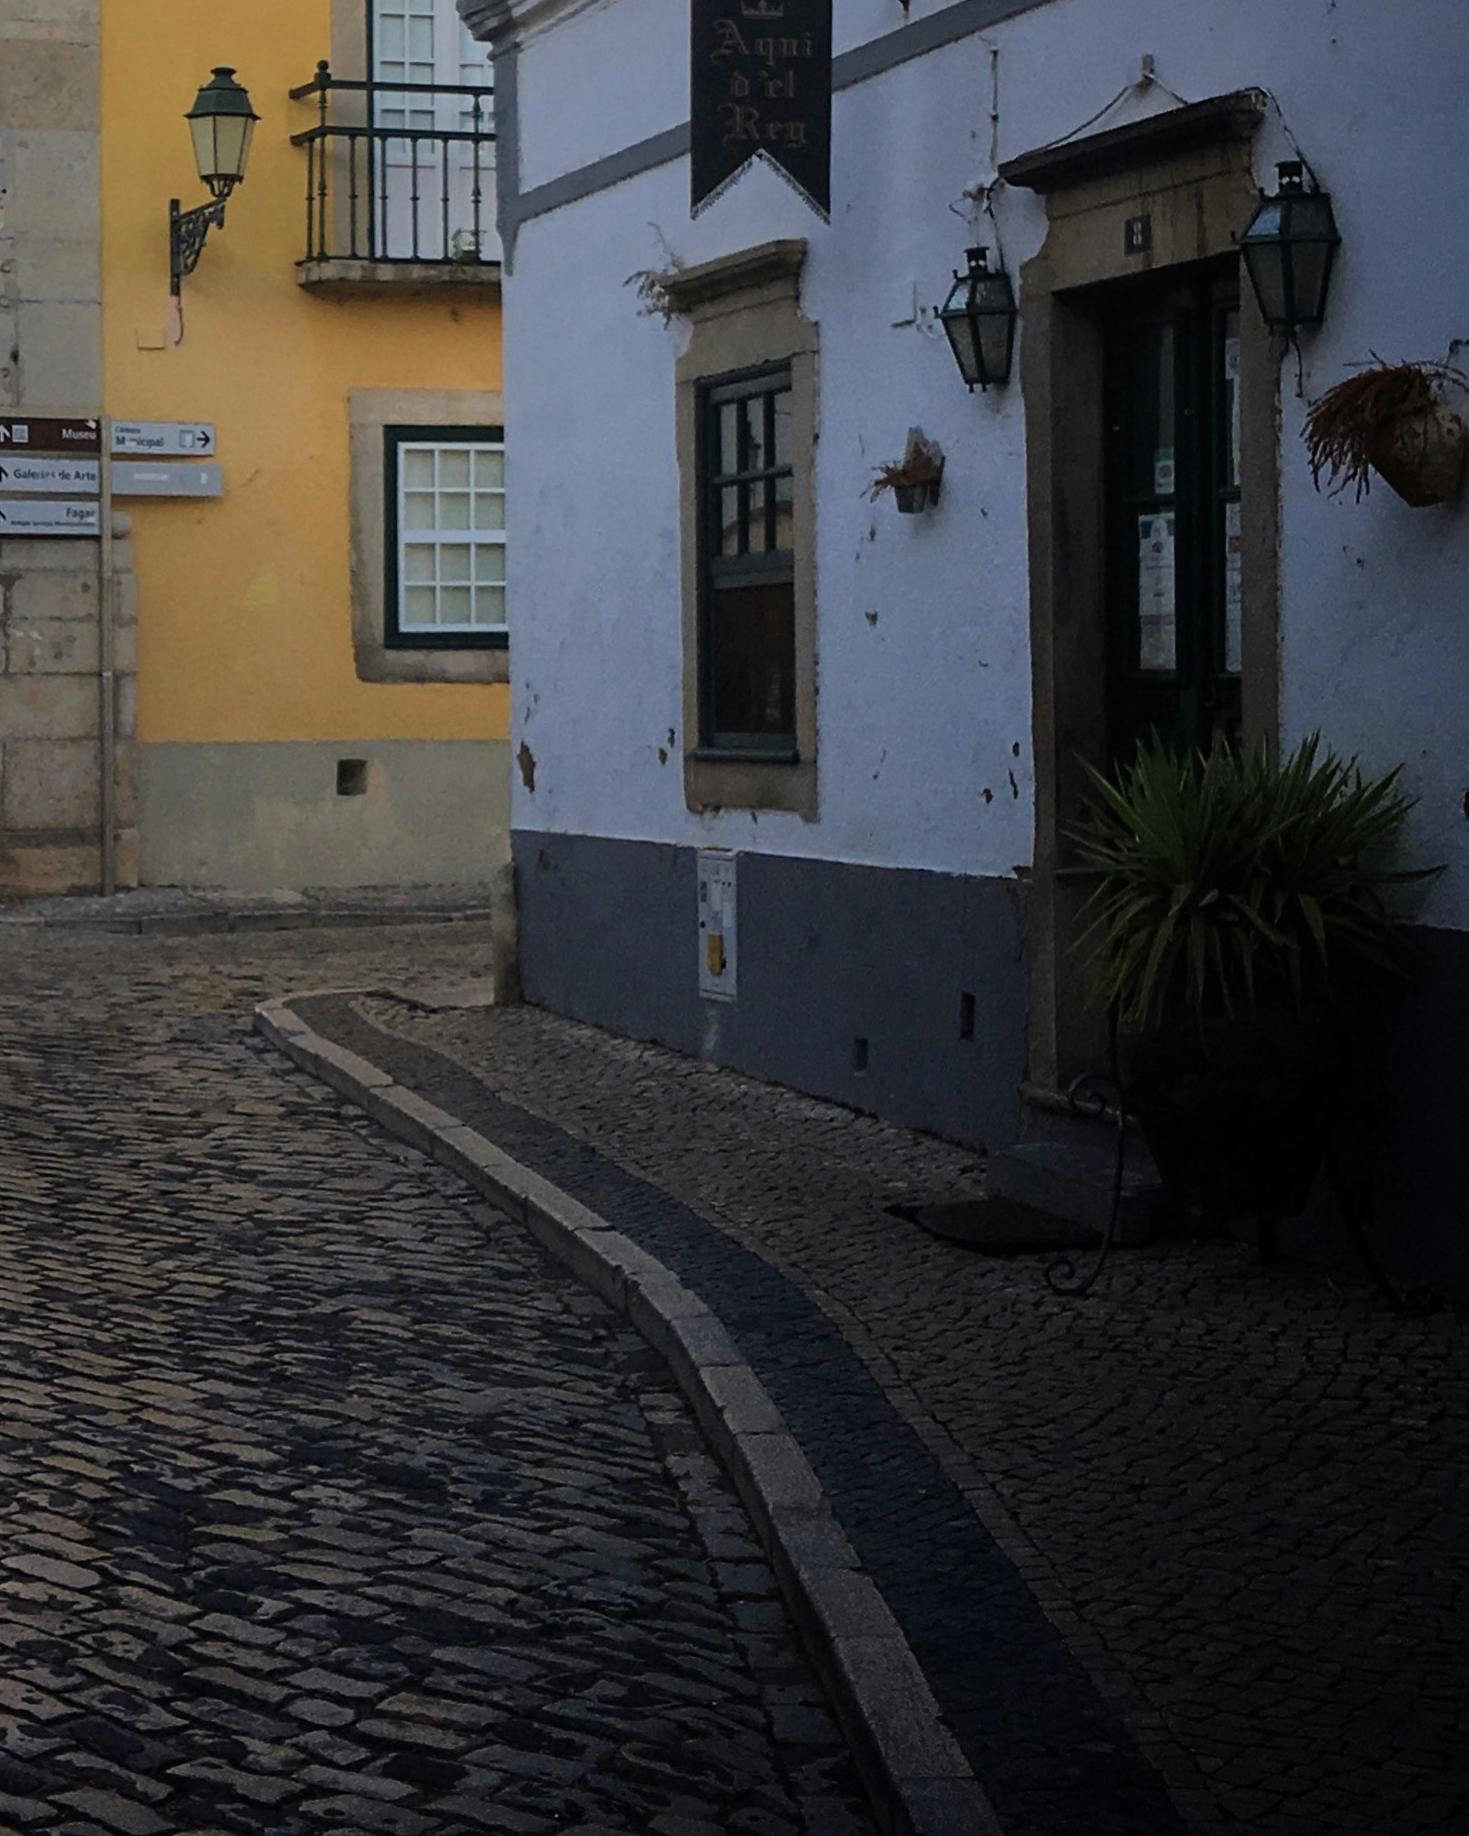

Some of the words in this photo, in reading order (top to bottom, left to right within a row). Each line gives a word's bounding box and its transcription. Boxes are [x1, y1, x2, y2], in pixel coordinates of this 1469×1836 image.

[717, 103, 806, 148] Rey
[1133, 221, 1143, 245] 8
[61, 428, 97, 440] Museu
[115, 436, 164, 449] Micipal
[58, 469, 71, 480] de
[74, 470, 97, 481] Arte
